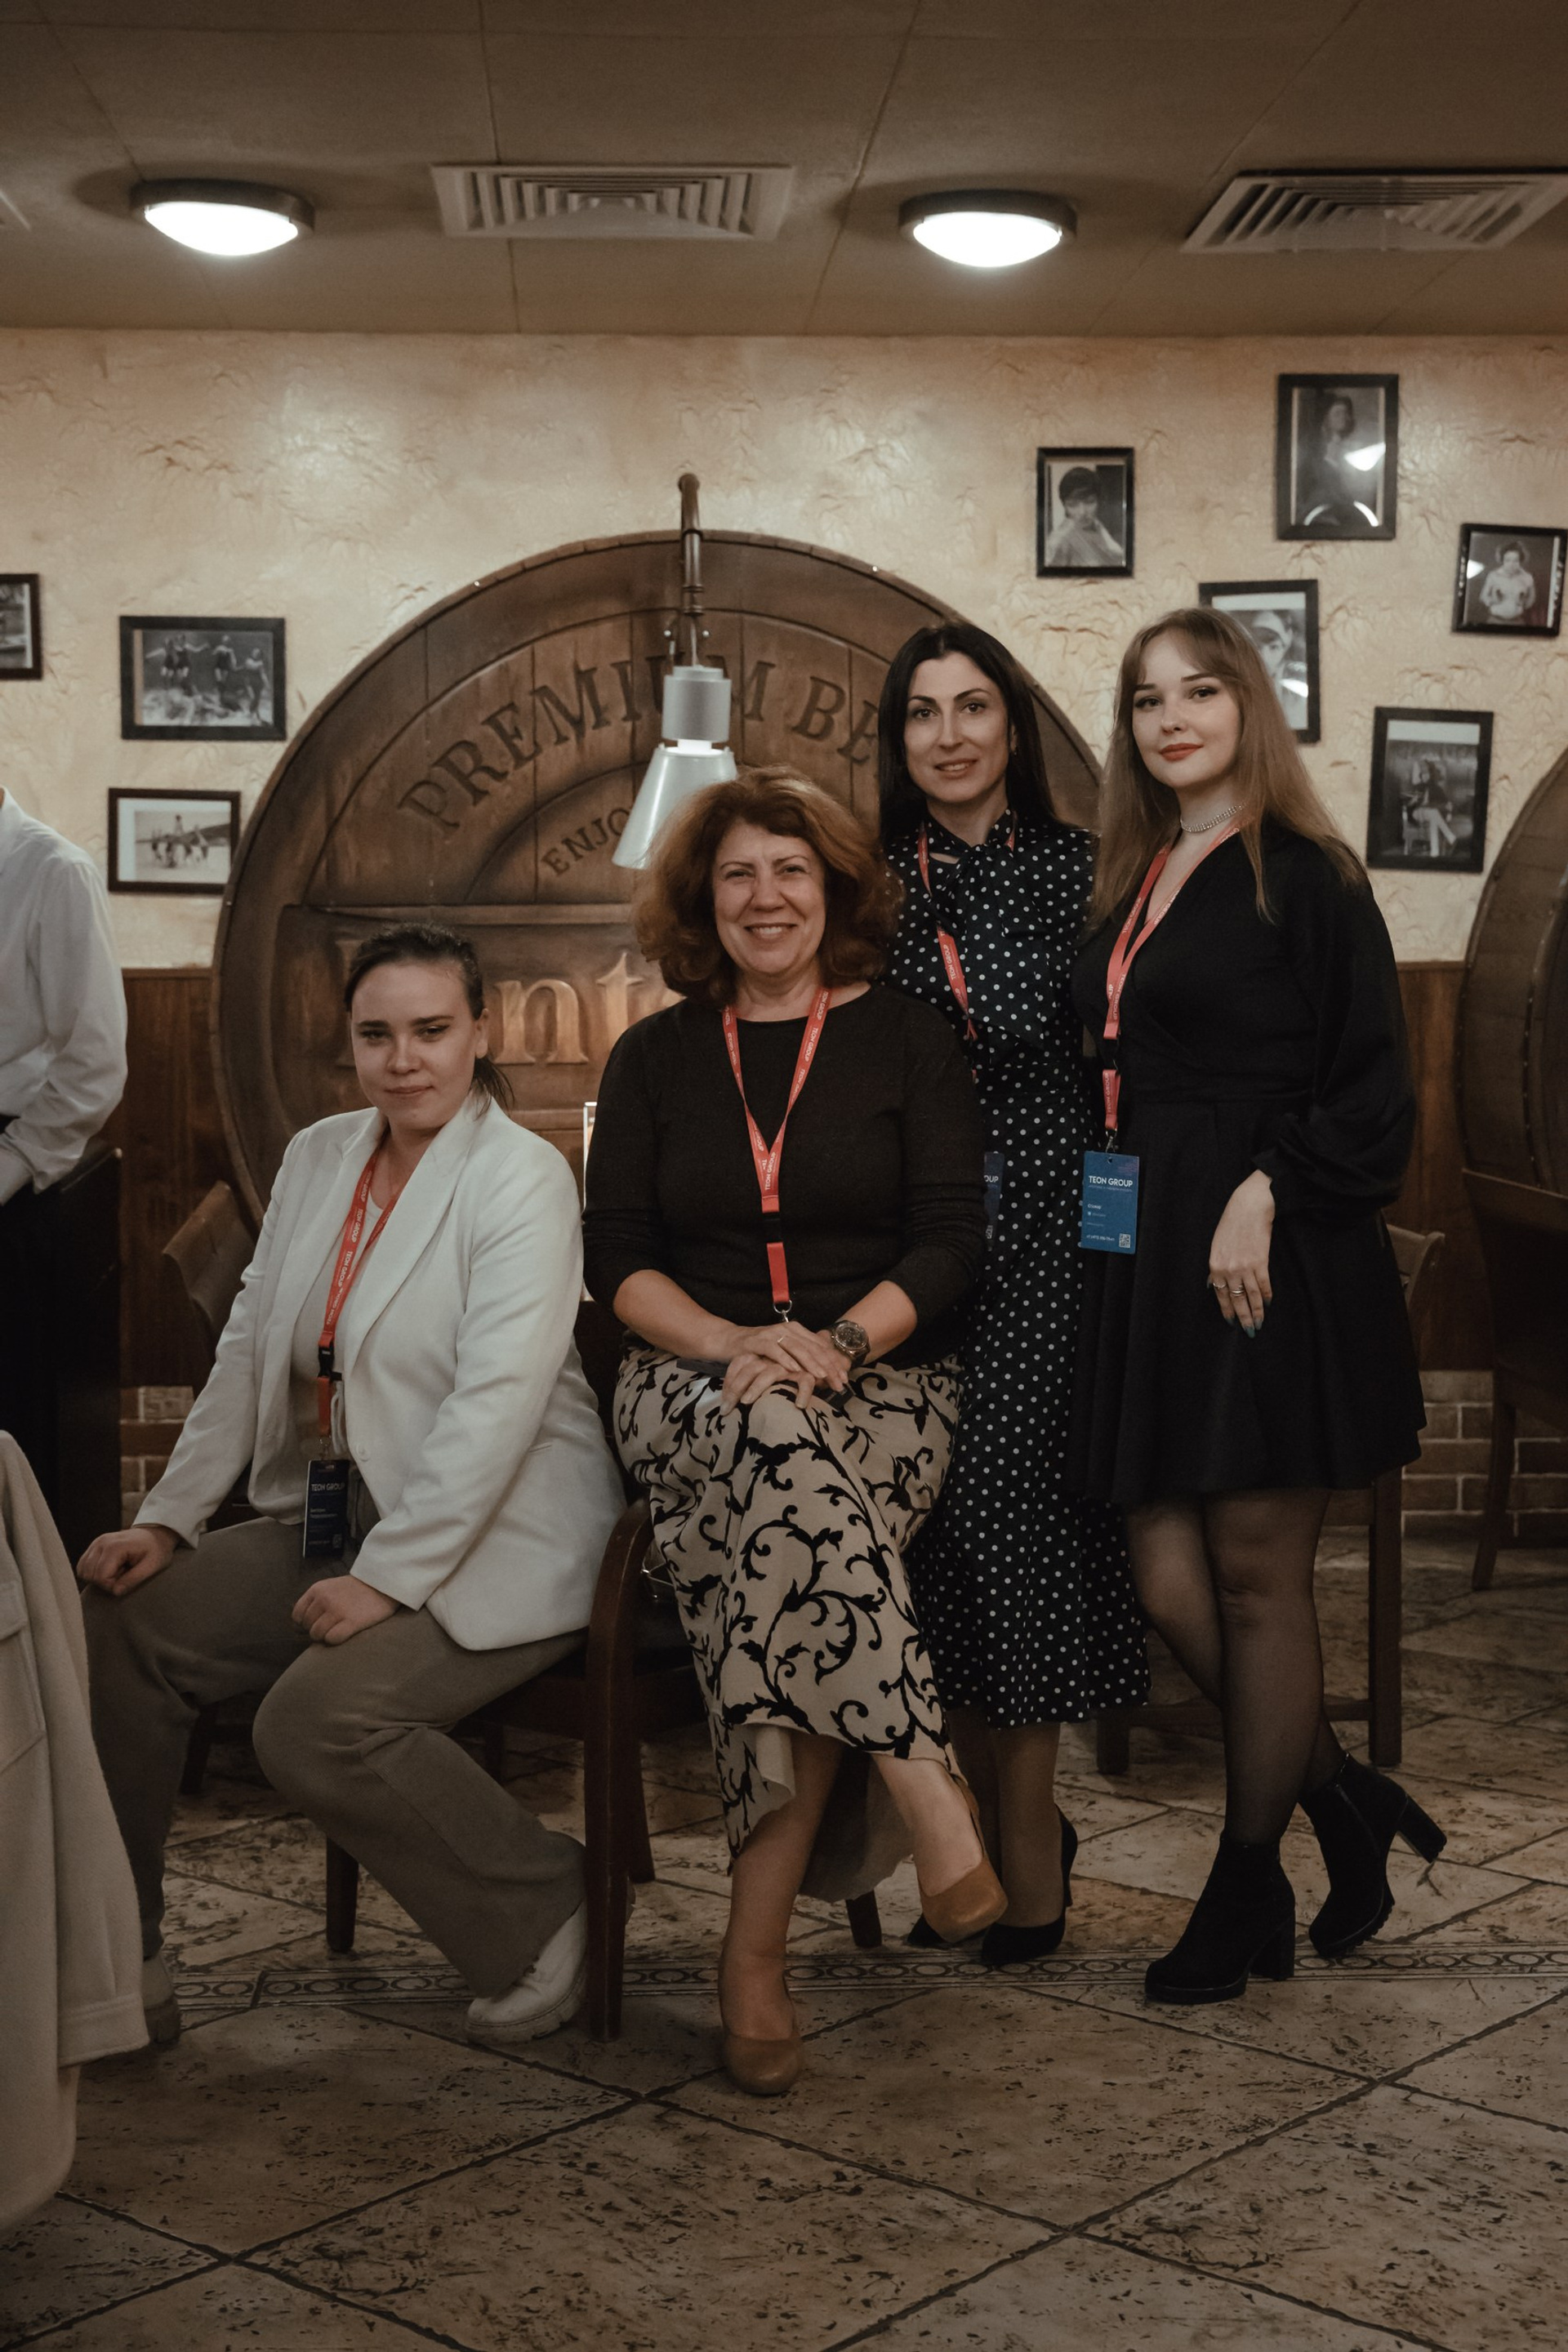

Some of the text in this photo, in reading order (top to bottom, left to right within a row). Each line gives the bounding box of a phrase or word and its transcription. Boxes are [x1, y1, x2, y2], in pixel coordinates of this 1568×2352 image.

[942, 944, 953, 964] GROUP
[948, 964, 956, 981] TEON
[1112, 973, 1127, 1020] TEON GROUP
[817, 1002, 826, 1021] GROUP
[804, 1027, 819, 1062] TEON GROUP
[767, 1152, 776, 1174] GROUP
[983, 1174, 1000, 1183] OUP
[1089, 1175, 1134, 1187] TEON GROUP
[337, 1250, 354, 1288] TEON GROUP
[311, 1482, 346, 1492] TEON GROUP
